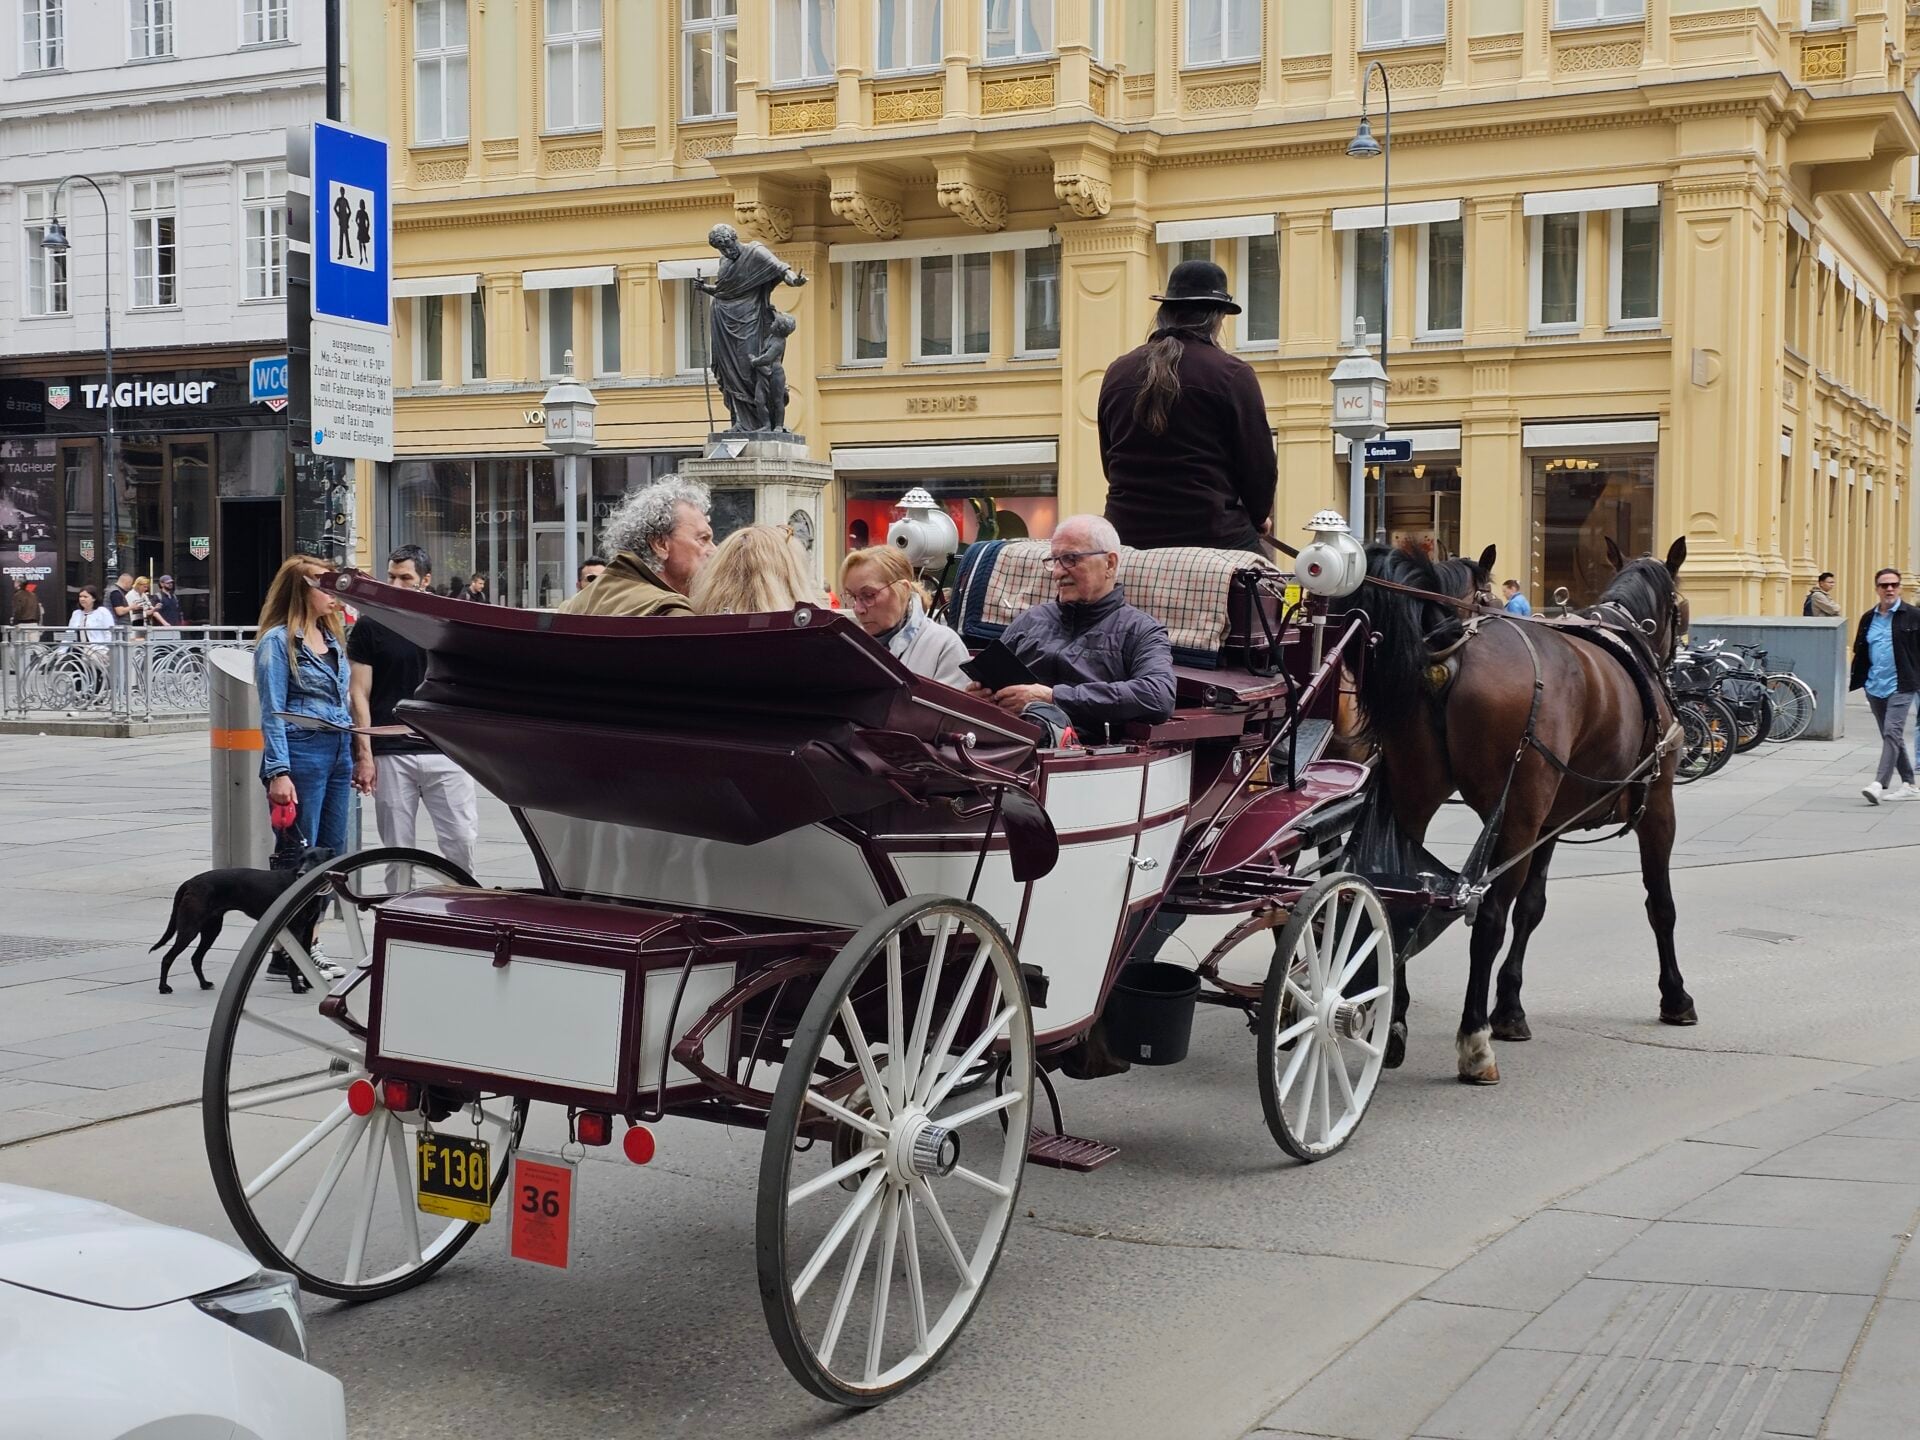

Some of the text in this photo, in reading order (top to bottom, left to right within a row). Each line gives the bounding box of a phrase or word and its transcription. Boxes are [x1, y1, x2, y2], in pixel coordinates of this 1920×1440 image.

[332, 340, 375, 354] ausgenommen
[256, 366, 280, 390] WC
[313, 365, 392, 388] Zufahrt zur Ladetätigkeit
[50, 388, 69, 396] TAG
[320, 383, 331, 392] mit
[332, 382, 365, 399] Fahrzeuge
[366, 388, 376, 399] bis
[1342, 396, 1364, 409] WC
[333, 414, 374, 429] und Taxi zum
[552, 418, 568, 430] WC
[324, 427, 384, 446] Aus- und Einsteigen
[1371, 447, 1397, 456] Graben
[422, 1143, 484, 1191] F130
[521, 1185, 560, 1218] 36
